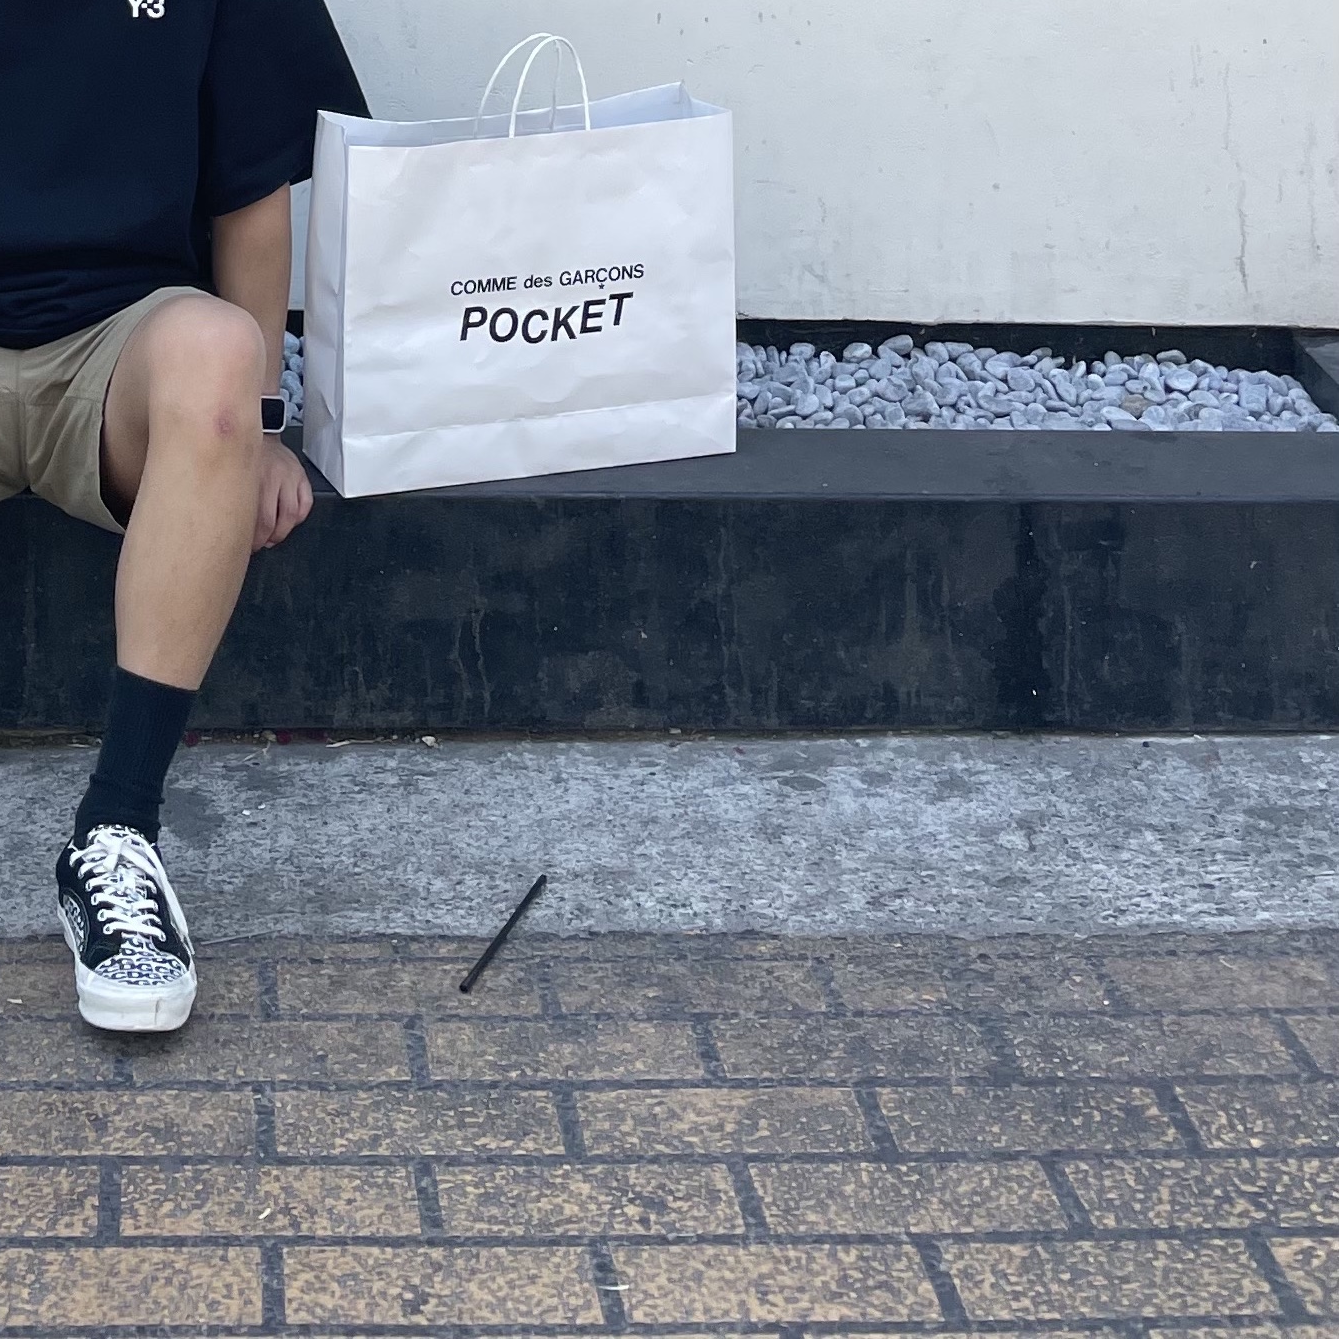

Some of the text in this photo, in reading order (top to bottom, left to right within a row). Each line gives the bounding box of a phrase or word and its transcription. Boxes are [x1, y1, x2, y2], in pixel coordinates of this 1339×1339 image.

[450, 263, 645, 296] COMME des GARÇONS
[459, 291, 634, 344] POCKET
